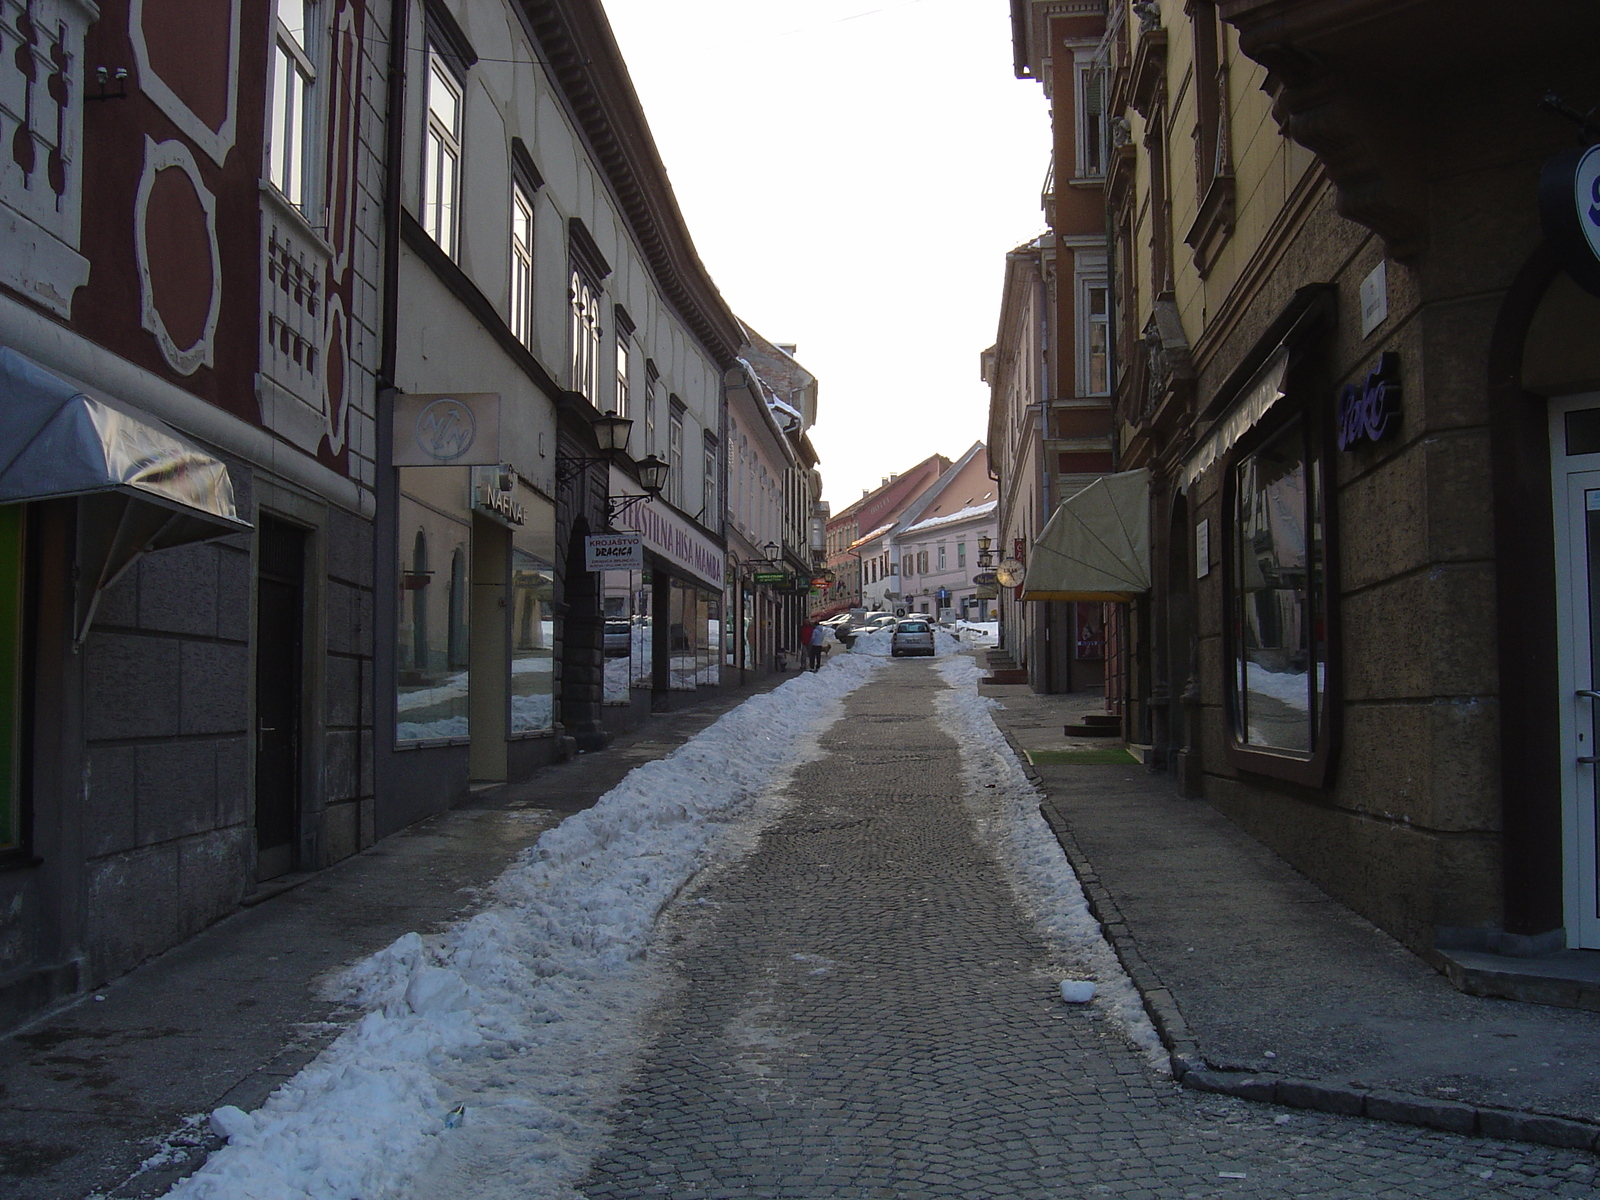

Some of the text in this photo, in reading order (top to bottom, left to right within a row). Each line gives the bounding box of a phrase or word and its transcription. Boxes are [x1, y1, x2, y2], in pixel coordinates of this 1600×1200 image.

[621, 488, 722, 583] TEKSTILNA HIŠA MAMBA
[590, 538, 640, 547] KROJAŠTVO
[595, 546, 633, 557] DRAGICA
